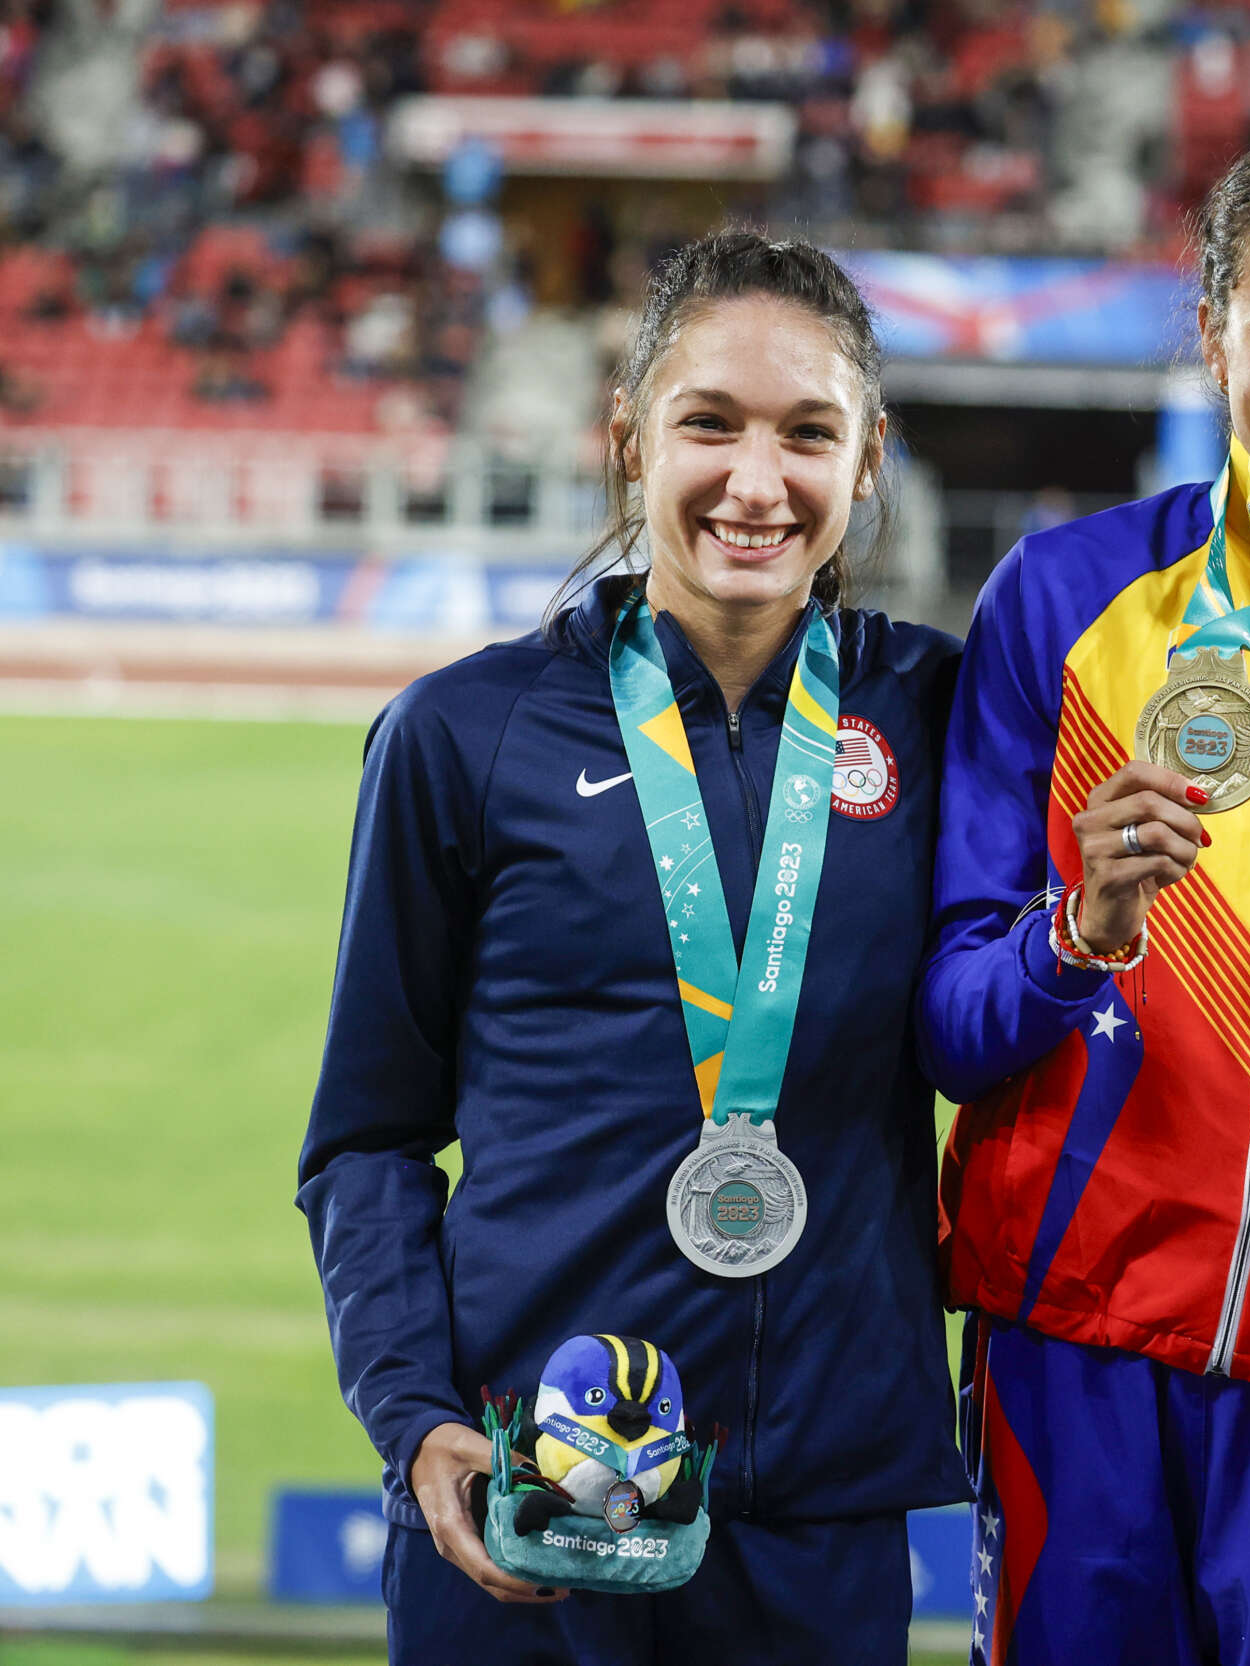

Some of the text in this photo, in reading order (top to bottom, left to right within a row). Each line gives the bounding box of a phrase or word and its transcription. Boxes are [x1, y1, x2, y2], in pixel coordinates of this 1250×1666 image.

[842, 718, 881, 742] STATES
[1187, 727, 1228, 739] Santiago
[1184, 738, 1228, 756] 2023
[832, 776, 897, 816] AMERICAN TEAM
[775, 842, 802, 897] 2023
[758, 900, 793, 992] Santiago
[717, 1194, 759, 1204] Santiago
[717, 1205, 759, 1221] 2023
[566, 1428, 610, 1456] 2023
[647, 1442, 675, 1458] Santiago
[542, 1530, 669, 1558] Santiago 2023
